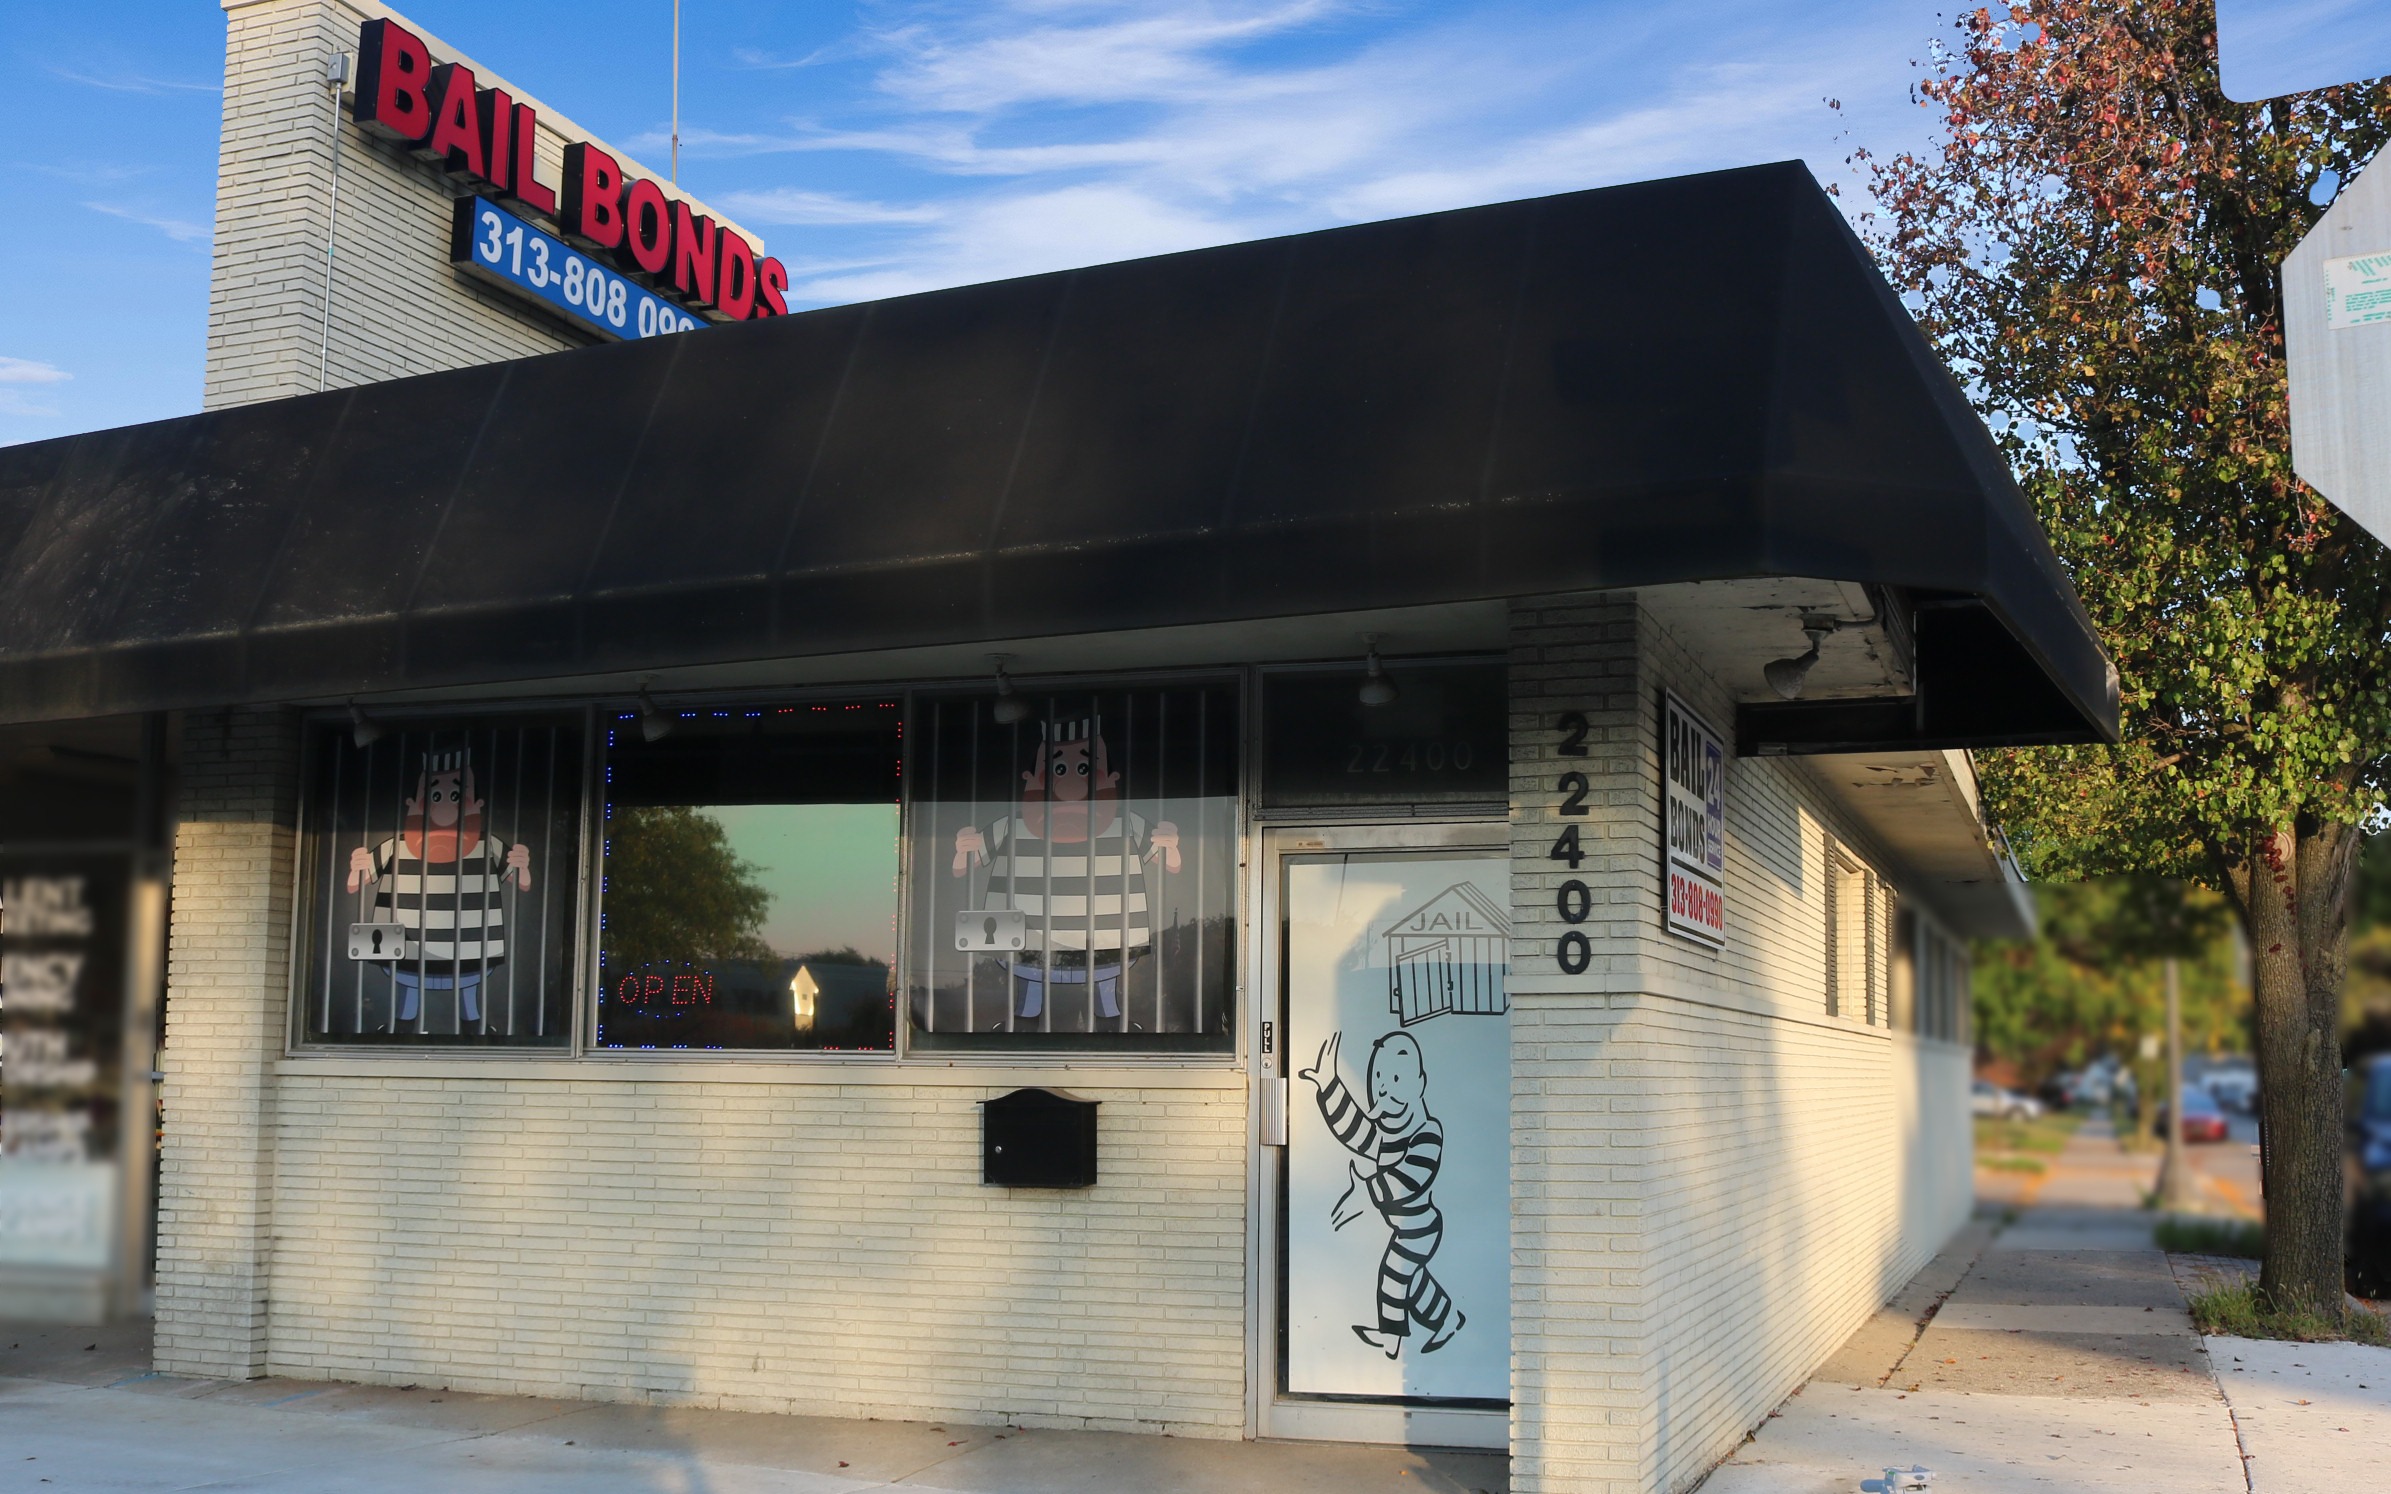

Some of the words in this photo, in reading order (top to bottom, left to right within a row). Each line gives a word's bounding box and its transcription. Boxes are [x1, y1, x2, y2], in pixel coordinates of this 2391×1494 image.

[375, 17, 556, 216] BAIL
[579, 141, 789, 322] BONDS
[478, 210, 628, 329] 313-808
[1346, 741, 1474, 774] 22400
[1669, 708, 1705, 802] BAIL
[1707, 756, 1721, 811] 24
[1551, 710, 1592, 975] 22400
[1670, 795, 1705, 864] BONDS
[1707, 812, 1721, 841] HOUR
[1409, 911, 1484, 932] JAIL
[618, 975, 713, 1005] OPEN
[1263, 1022, 1271, 1053] PULL
